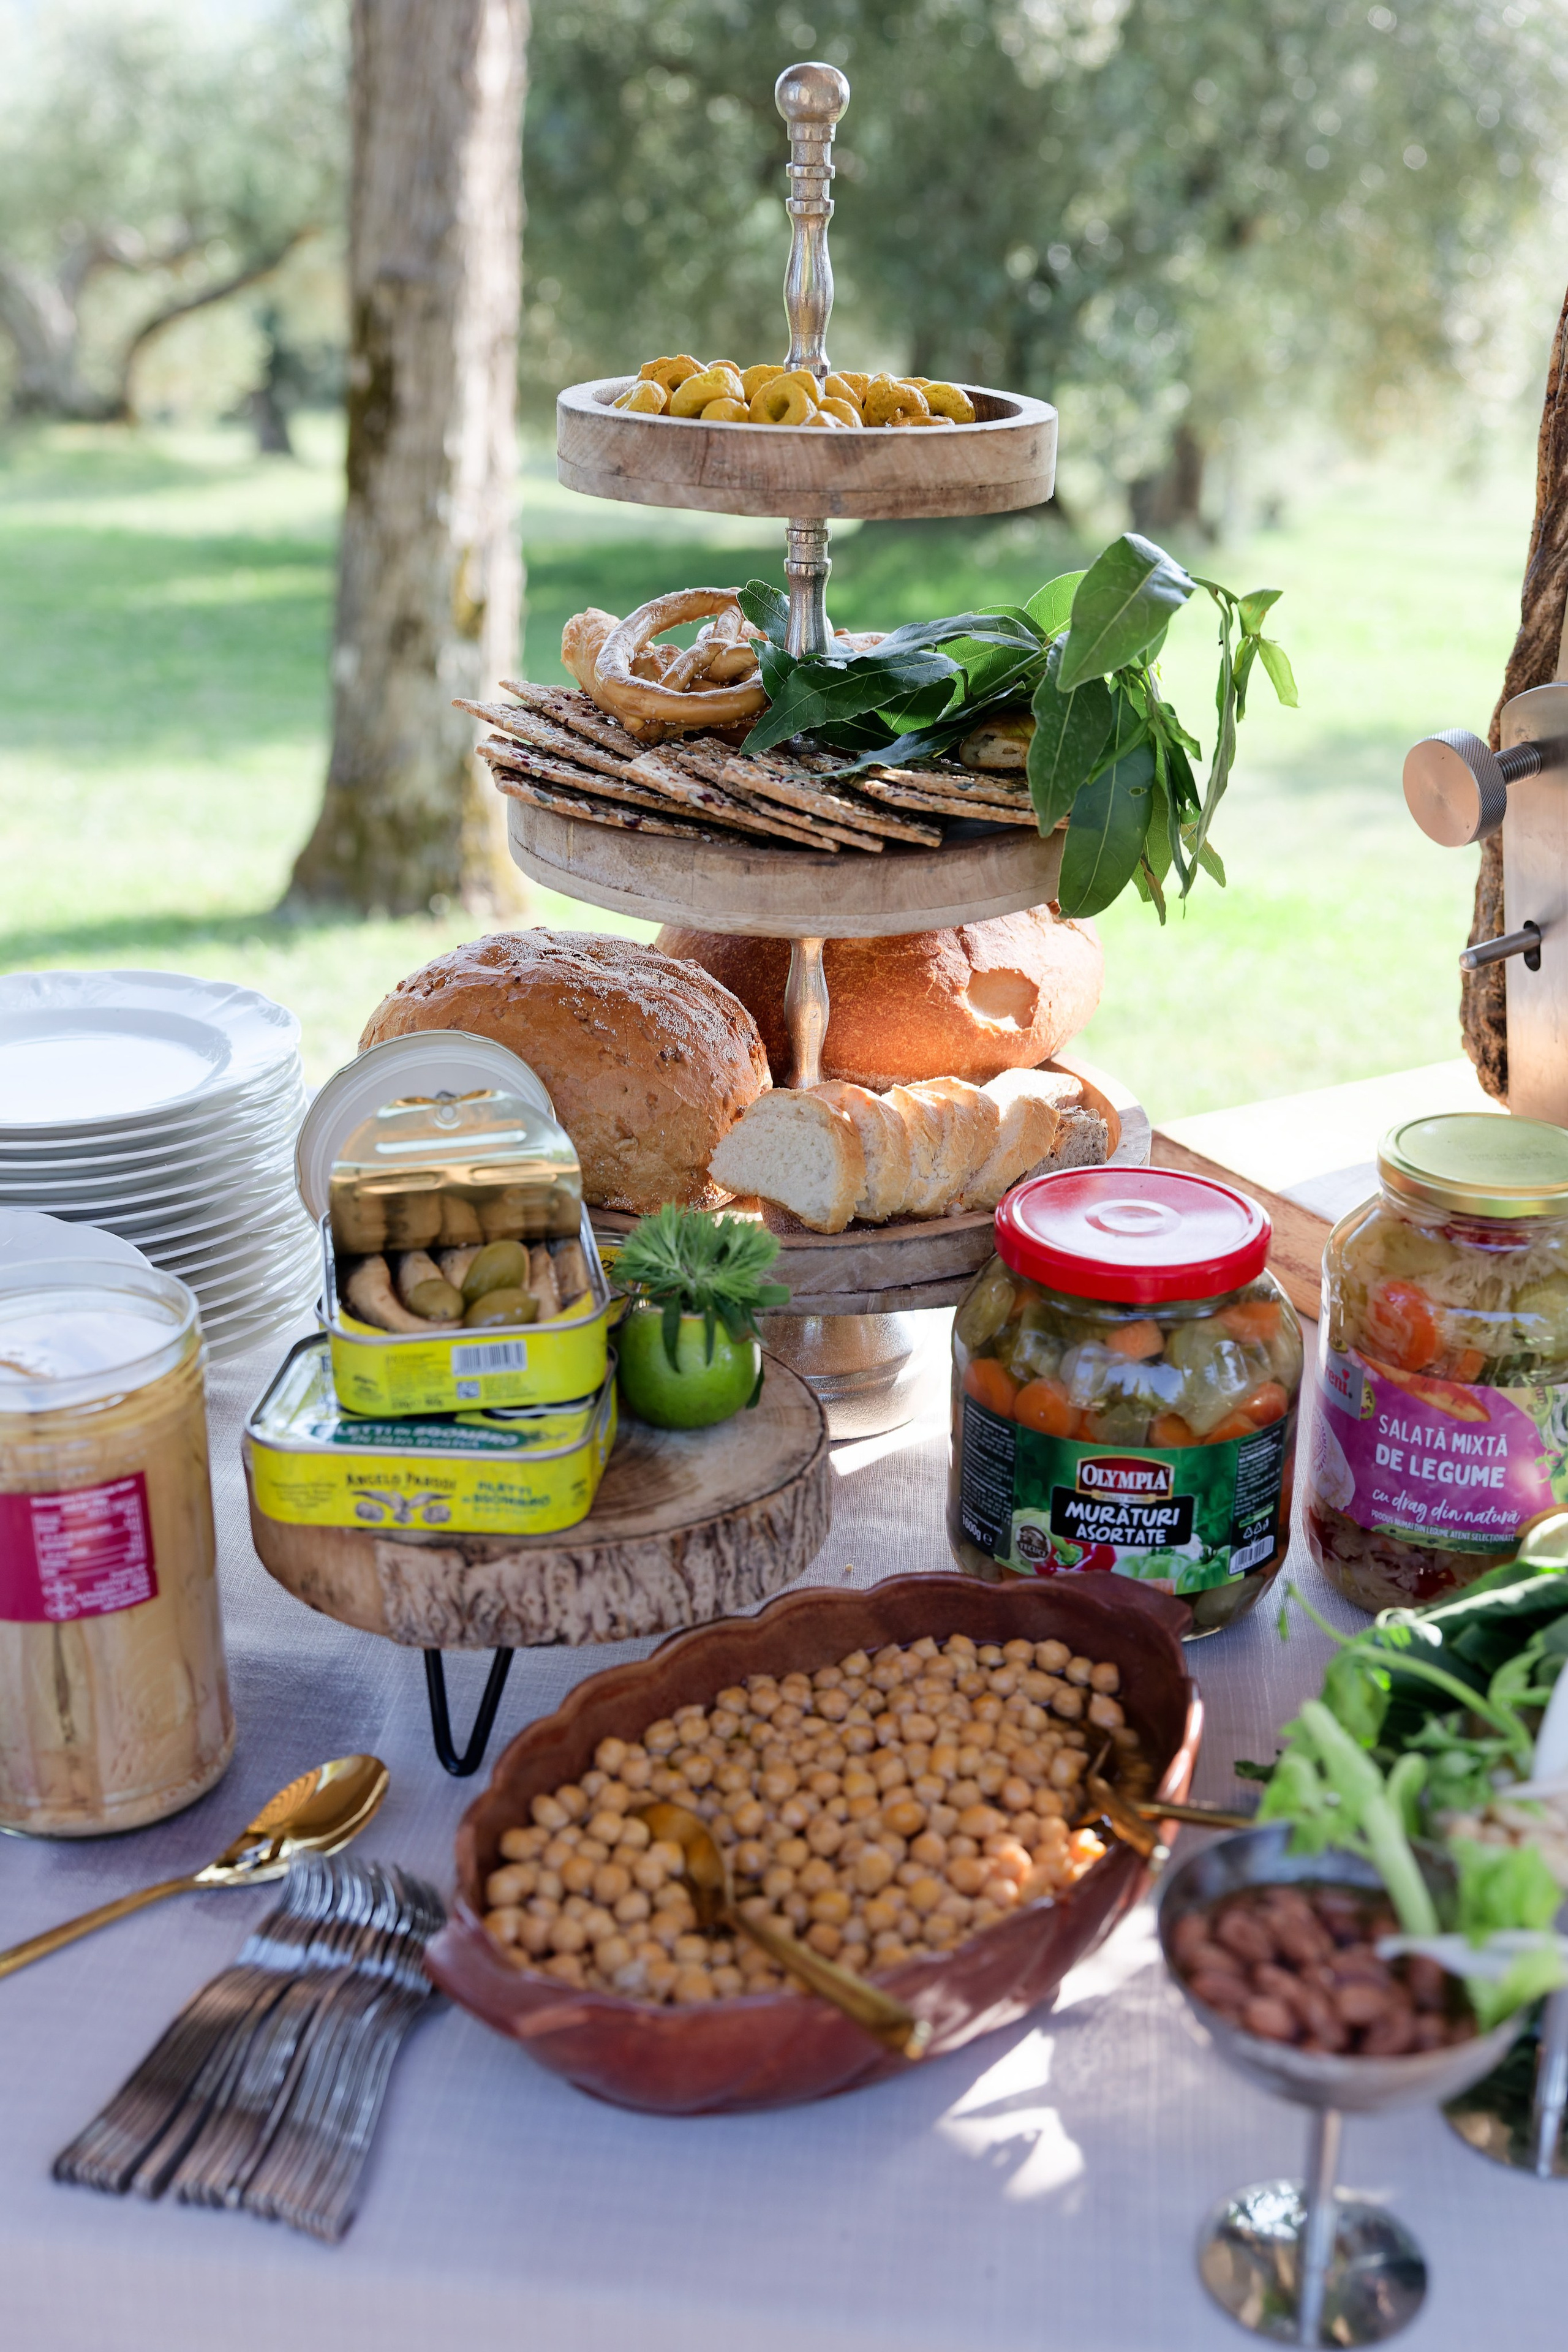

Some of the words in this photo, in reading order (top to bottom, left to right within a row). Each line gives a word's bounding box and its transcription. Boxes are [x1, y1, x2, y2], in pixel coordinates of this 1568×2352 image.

[1378, 1414, 1446, 1451] SALATĂ
[1451, 1432, 1508, 1457] MIXTĂ
[1081, 1464, 1168, 1490] OLYMPIA
[1375, 1442, 1404, 1472] DE
[1409, 1454, 1506, 1488] LEGUME
[1372, 1488, 1389, 1503] cu
[1391, 1489, 1428, 1523] drag
[1430, 1498, 1464, 1521] din
[1464, 1506, 1521, 1525] natură
[1076, 1523, 1166, 1544] ASORTATE
